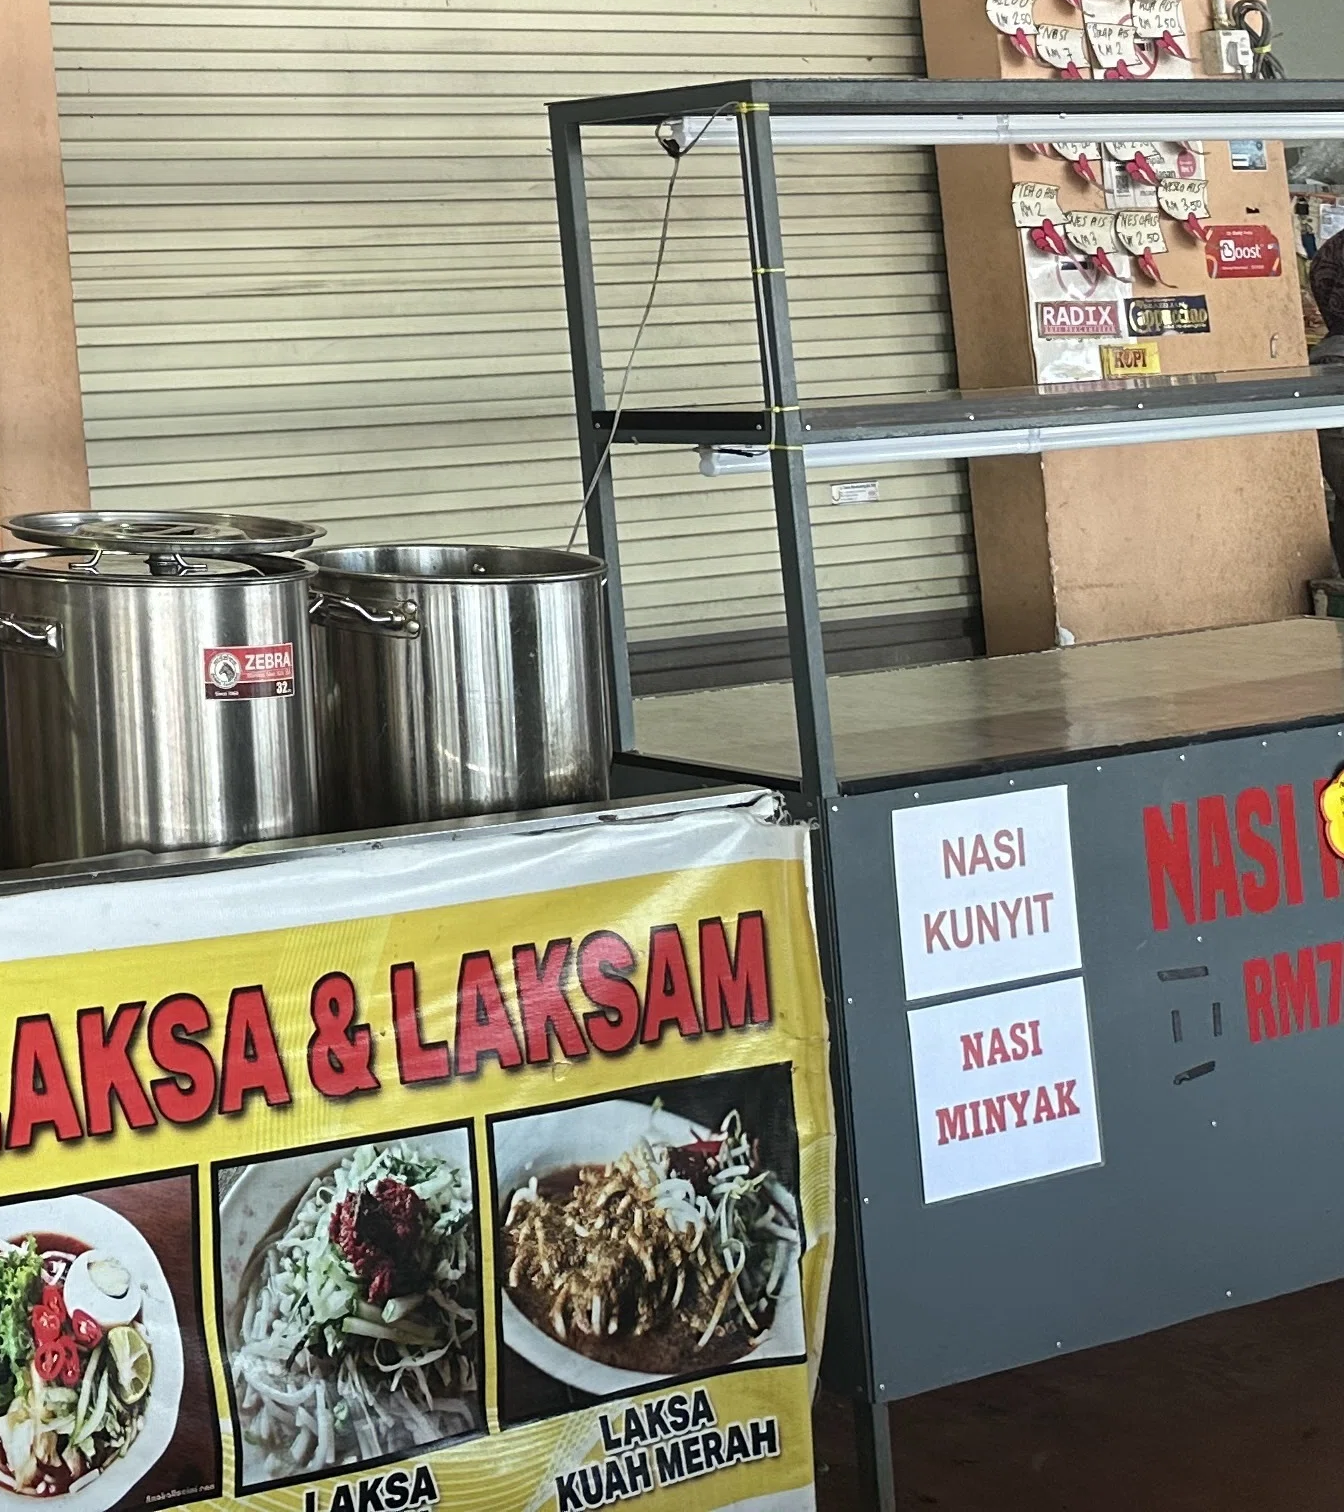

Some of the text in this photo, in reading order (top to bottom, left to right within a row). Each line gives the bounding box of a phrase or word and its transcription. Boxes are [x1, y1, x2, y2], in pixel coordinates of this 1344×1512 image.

[1043, 306, 1113, 326] RADIX
[1115, 349, 1147, 368] KOPI
[245, 653, 291, 671] ZEBRA
[942, 827, 1025, 879] NASI
[1143, 784, 1304, 932] NASI
[924, 892, 1054, 954] KUNYIT
[306, 970, 379, 1098] &
[388, 909, 774, 1085] LAKSAM
[960, 1020, 1043, 1071] NASI
[936, 1079, 1080, 1145] MINYAK
[600, 1388, 714, 1451] LAKSA
[307, 1466, 438, 1512] LAKSA
[555, 1420, 777, 1511] KUAH MERAH
